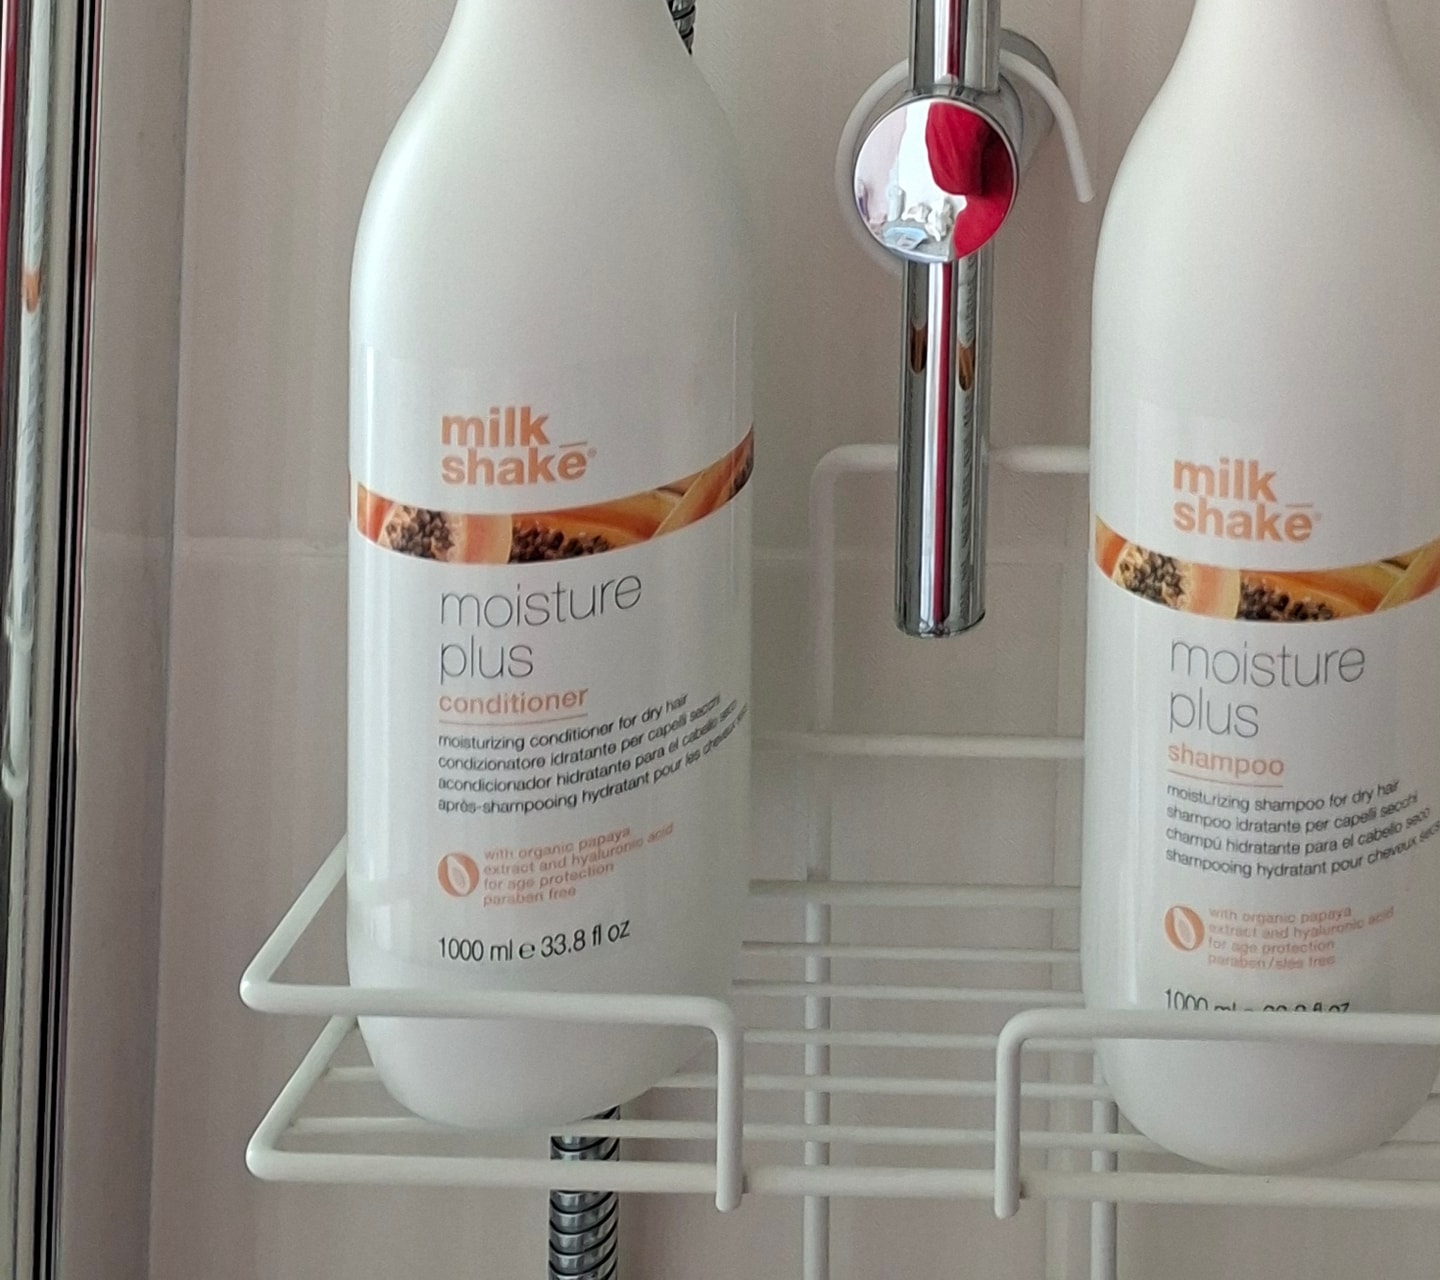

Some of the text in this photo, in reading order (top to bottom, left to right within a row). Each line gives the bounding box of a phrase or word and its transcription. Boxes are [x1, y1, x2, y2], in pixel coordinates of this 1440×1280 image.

[441, 406, 550, 447] milk
[1173, 456, 1278, 502] milk
[440, 575, 643, 629] moisture
[440, 636, 534, 686] plus
[1170, 640, 1366, 689] moisture
[438, 688, 589, 715] conditioner
[1169, 686, 1260, 738] plus
[438, 693, 689, 752] moisturizing conditioner for dry hair
[438, 756, 546, 772] condizionatore
[550, 742, 617, 767] idratante
[620, 732, 645, 755] per
[438, 775, 552, 791] acondicionador
[556, 759, 631, 787] hidratante
[634, 746, 665, 770] para
[668, 736, 679, 753] el
[1167, 742, 1285, 779] shampoo
[438, 793, 578, 815] après-shampooing
[582, 771, 650, 804] hydratant
[653, 758, 683, 785] pour
[1166, 780, 1399, 814] moisturizing shampoo for dry hair
[1166, 804, 1232, 831] shampoo
[1235, 817, 1302, 834] idratante
[1304, 819, 1329, 835] per
[1333, 806, 1377, 829] capelli
[483, 822, 674, 876] extract and hyaluronic acid
[484, 826, 631, 861] with organic papaya
[1166, 826, 1222, 851] champú
[1226, 837, 1301, 856] hidratante
[1304, 840, 1338, 857] para
[1342, 833, 1354, 850] el
[484, 862, 615, 892] for age protection
[1165, 848, 1253, 880] shampooing
[1256, 860, 1327, 880] hydratant
[1330, 855, 1363, 876] pour
[483, 886, 577, 908] paraben free
[1208, 906, 1352, 927] with organic papaya
[1208, 906, 1395, 941] extract and hyaluronic acid
[439, 937, 485, 962] 1000
[489, 938, 513, 962] ml
[540, 928, 587, 959] 33.8
[592, 923, 602, 947] fl
[607, 919, 632, 944] oz
[1208, 937, 1335, 957] for age protection
[1308, 954, 1336, 968] free
